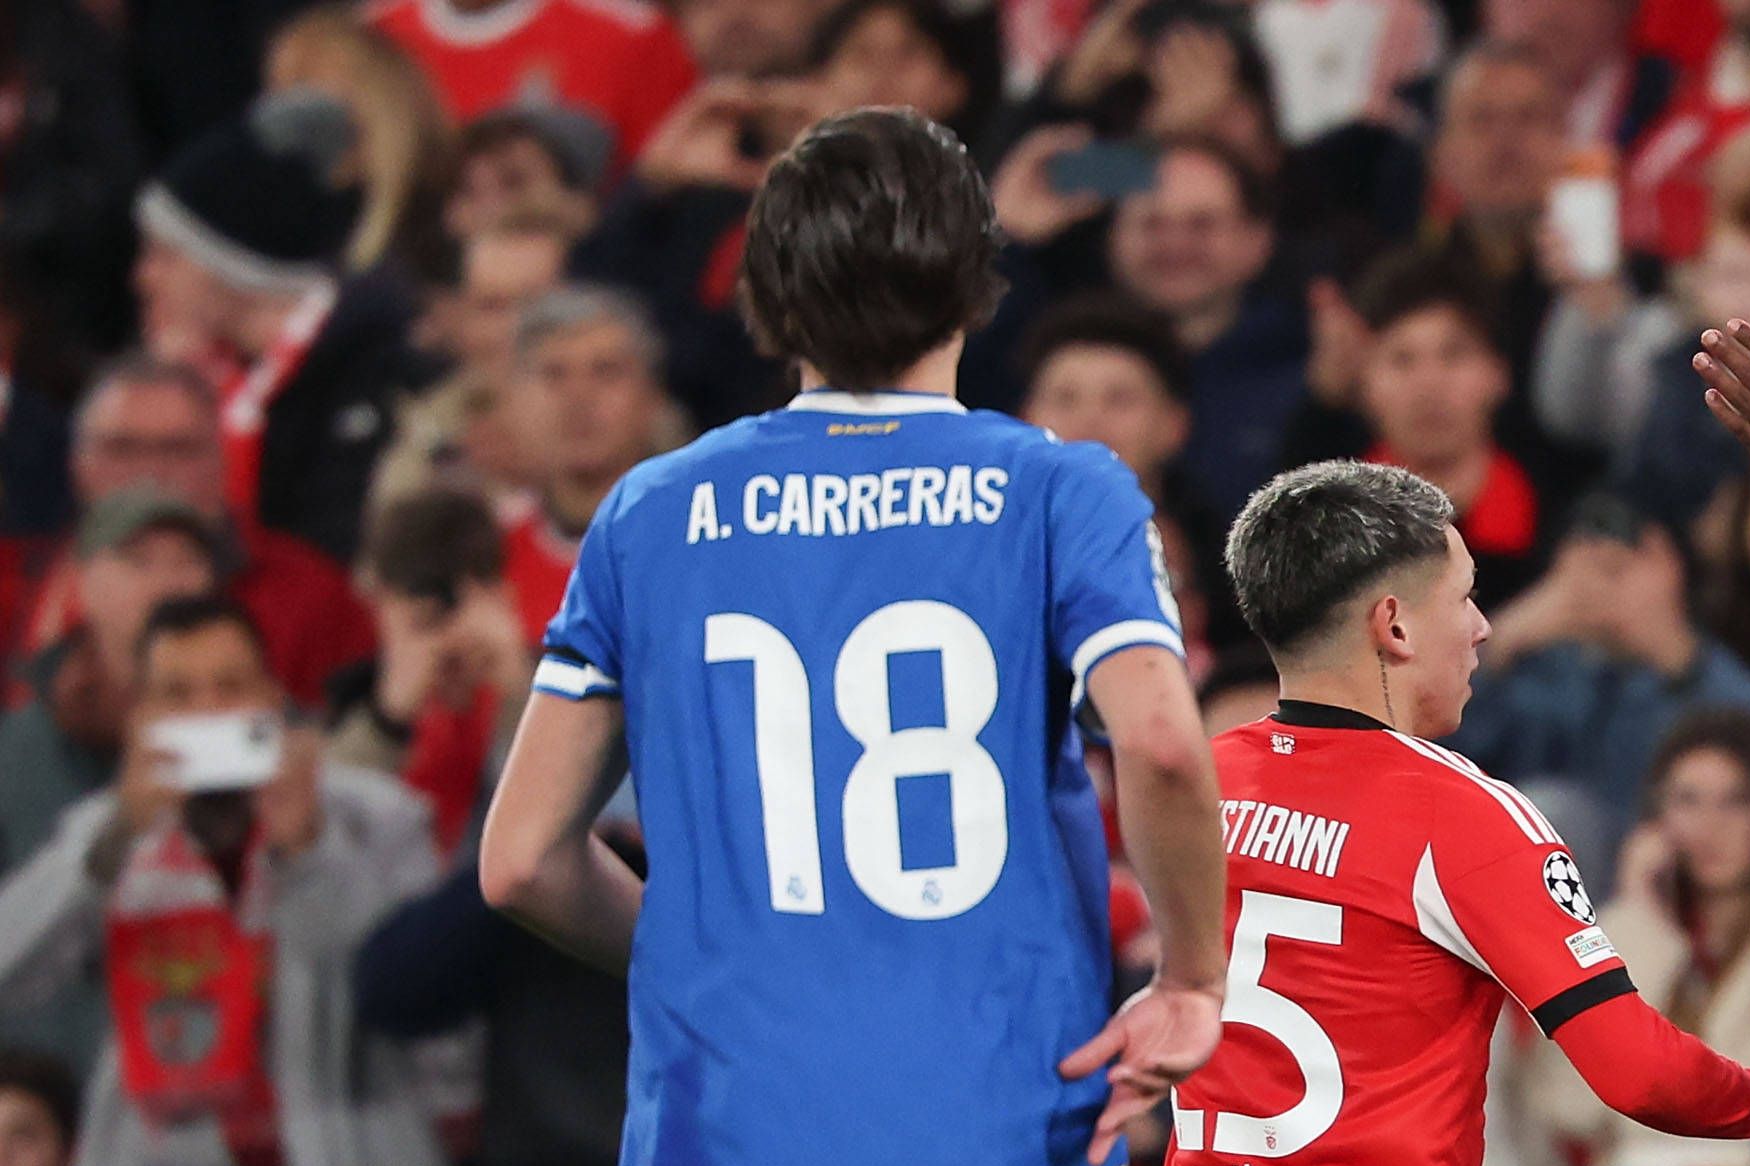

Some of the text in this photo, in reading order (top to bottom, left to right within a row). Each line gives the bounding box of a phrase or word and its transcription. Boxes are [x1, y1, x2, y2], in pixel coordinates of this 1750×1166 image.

[687, 465, 1008, 544] A. CARRERAS
[704, 600, 1009, 920] 18
[1218, 800, 1351, 878] STIANNI
[1171, 889, 1344, 1158] 5
